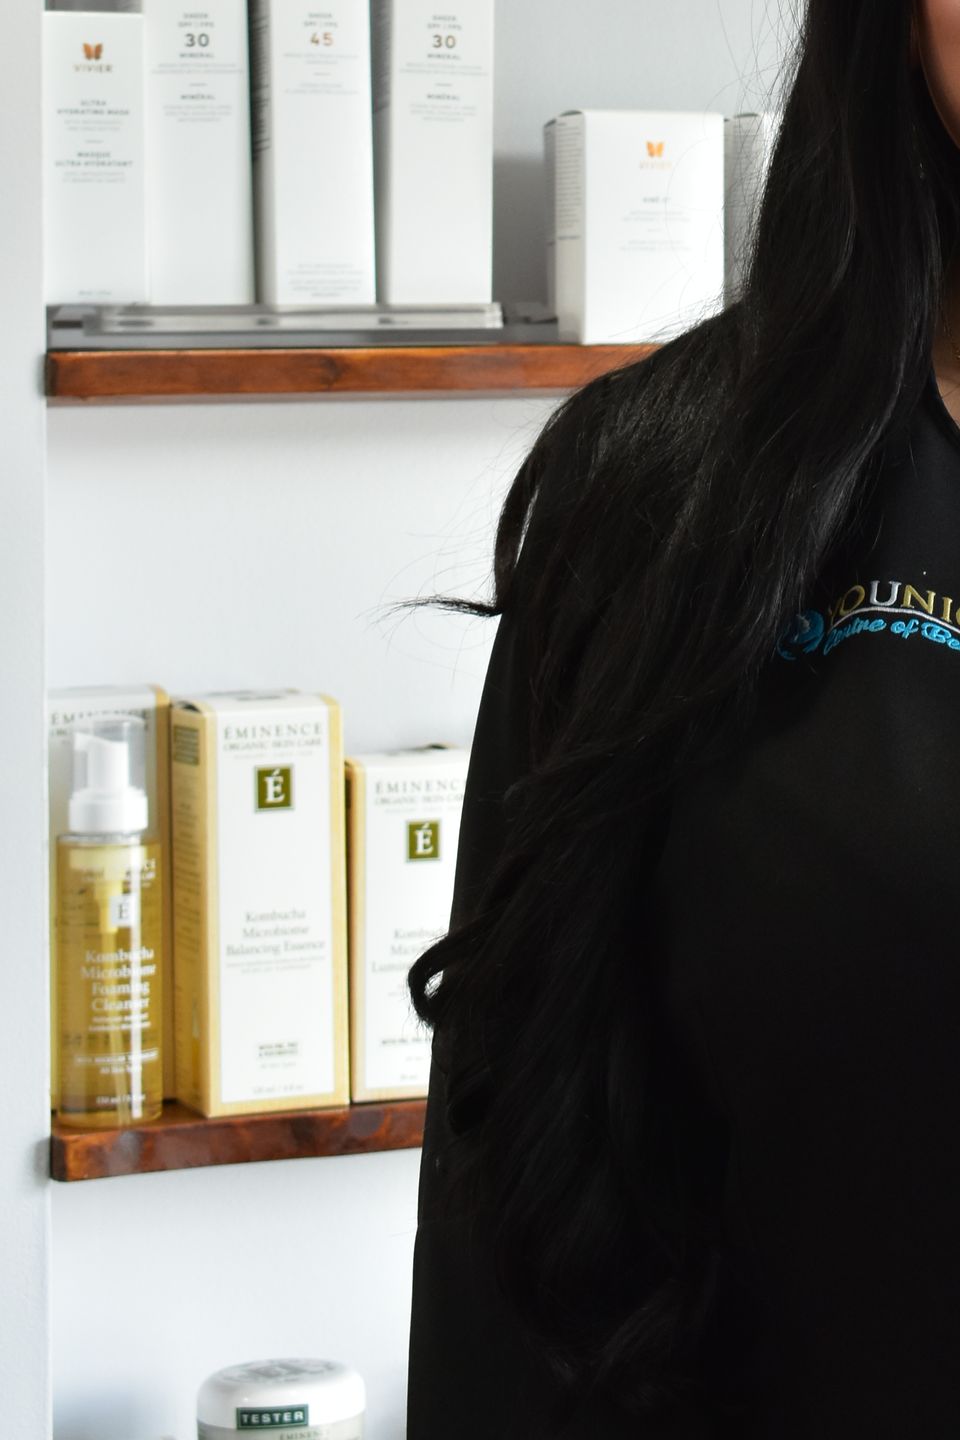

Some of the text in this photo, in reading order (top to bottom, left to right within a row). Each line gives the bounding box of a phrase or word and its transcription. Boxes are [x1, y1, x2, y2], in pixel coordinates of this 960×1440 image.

[185, 33, 210, 47] 30
[310, 32, 333, 47] 45
[432, 34, 456, 49] 30
[72, 64, 114, 74] VIVIER
[890, 619, 920, 640] of
[245, 907, 306, 923] Kombucha
[226, 941, 281, 957] Balancing
[242, 1410, 304, 1424] TESTER
